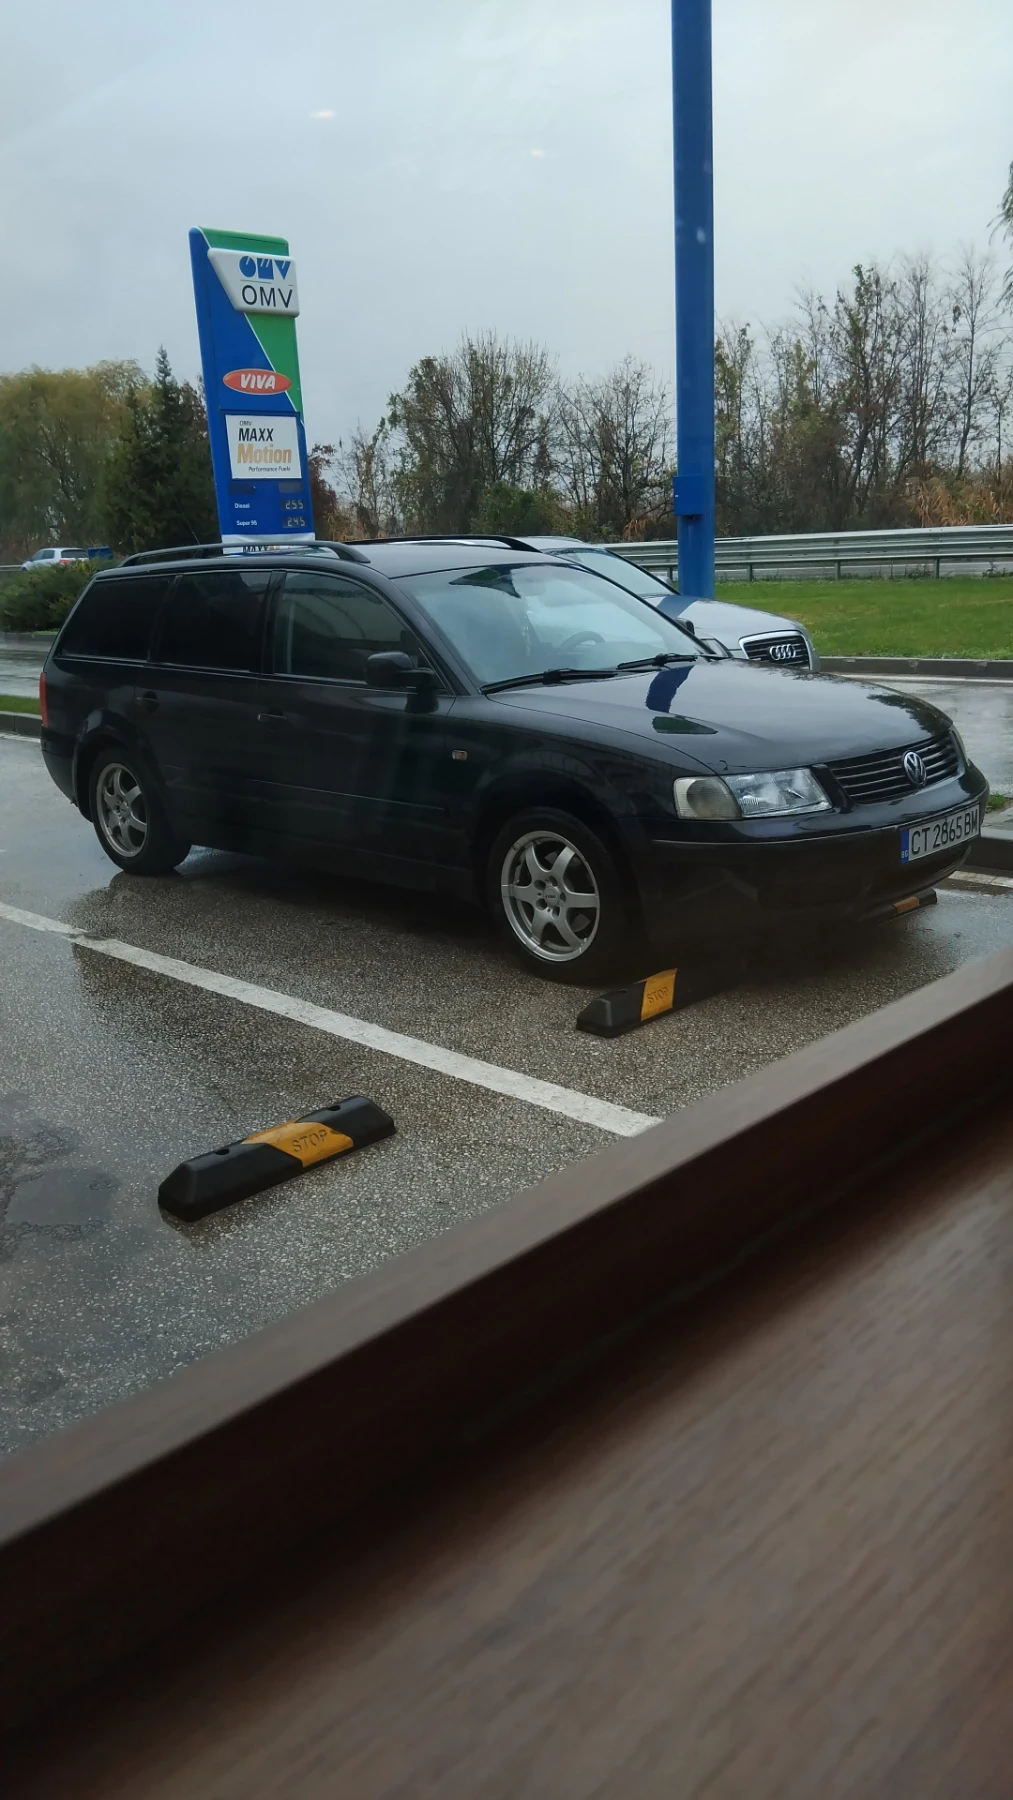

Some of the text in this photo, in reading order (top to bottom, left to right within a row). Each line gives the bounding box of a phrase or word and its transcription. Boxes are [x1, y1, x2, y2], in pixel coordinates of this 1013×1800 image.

[241, 284, 293, 308] OMV
[240, 373, 276, 390] VIVA
[238, 428, 274, 442] MAXX
[237, 443, 292, 464] Motion
[911, 808, 978, 855] CT 2865 BM
[901, 849, 909, 858] BG
[646, 986, 669, 1004] STOP
[291, 1129, 328, 1153] STOP
